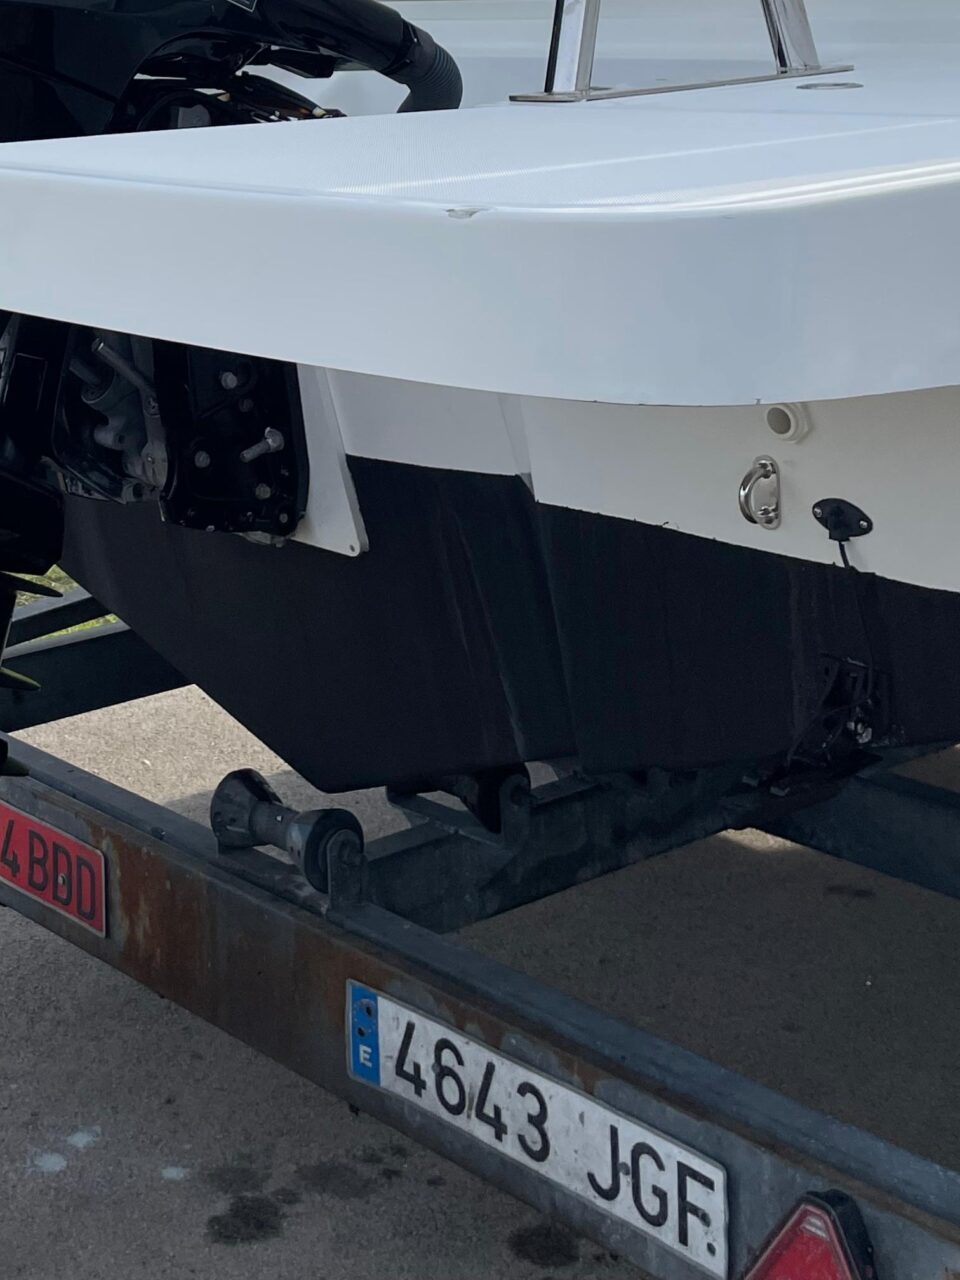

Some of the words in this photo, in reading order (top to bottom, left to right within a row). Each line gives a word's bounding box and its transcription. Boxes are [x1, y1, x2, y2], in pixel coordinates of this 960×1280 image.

[359, 1044, 373, 1068] E
[395, 1021, 550, 1163] 4643
[587, 1124, 715, 1247] JGF
